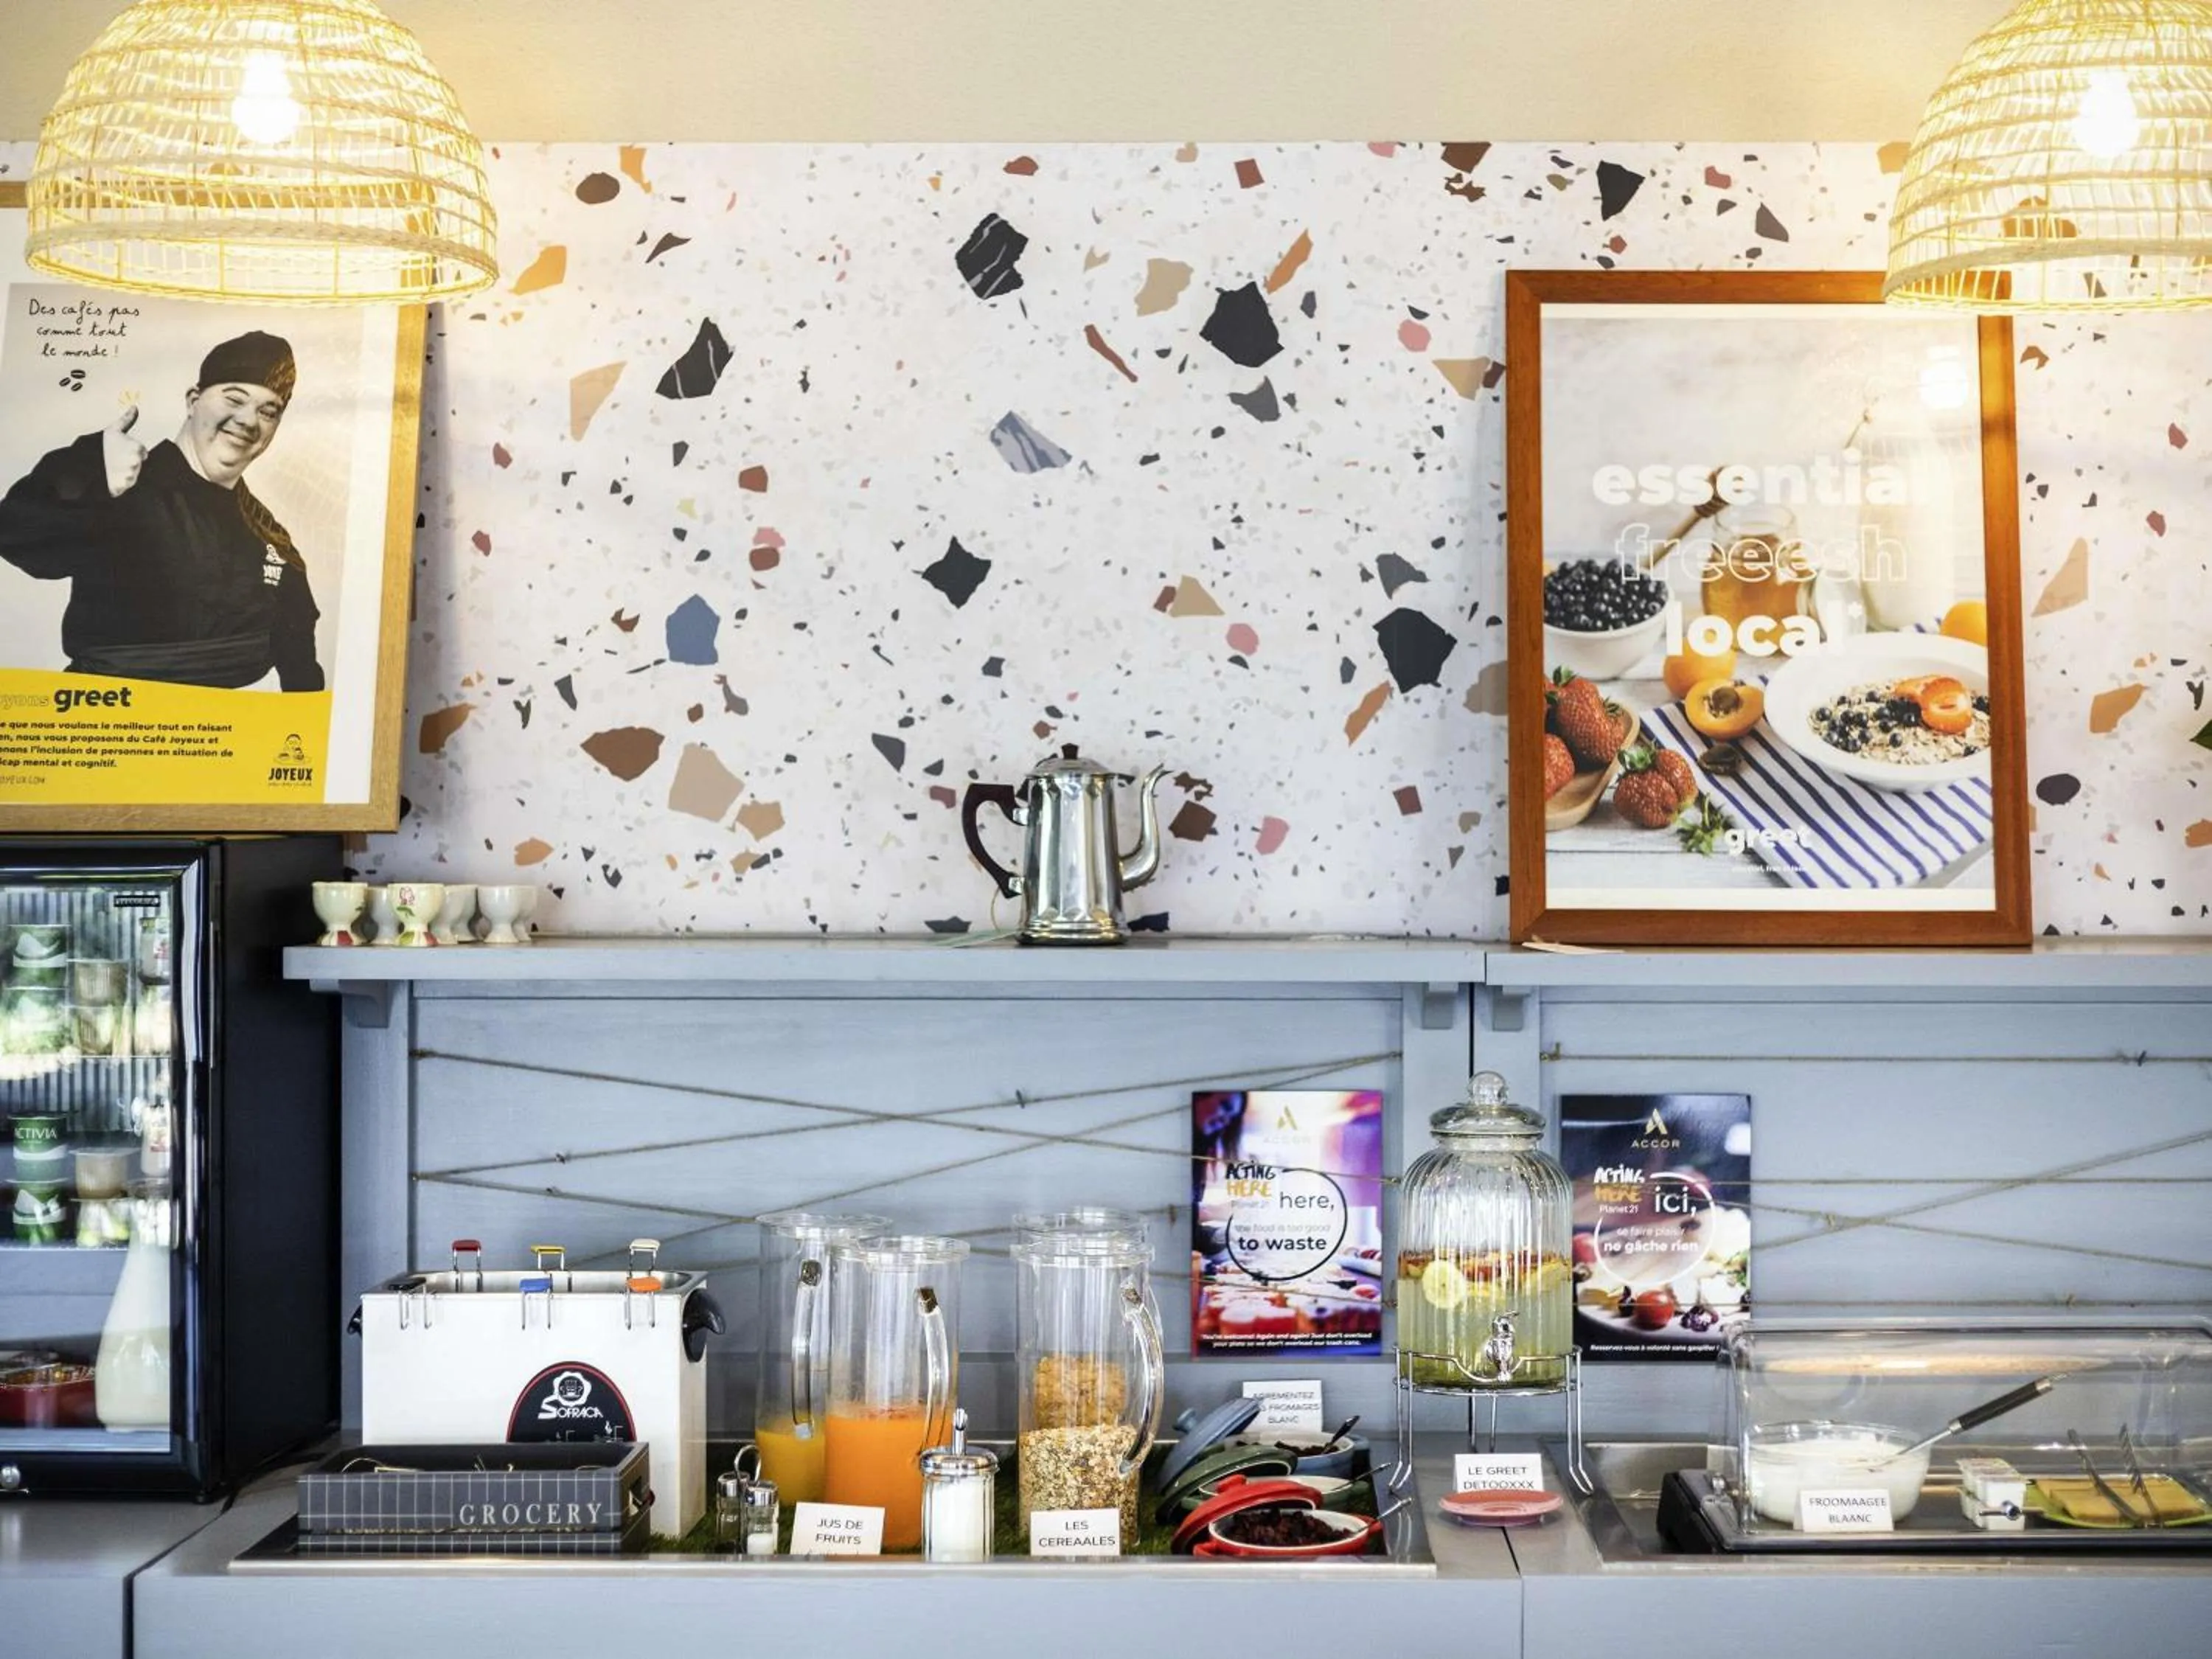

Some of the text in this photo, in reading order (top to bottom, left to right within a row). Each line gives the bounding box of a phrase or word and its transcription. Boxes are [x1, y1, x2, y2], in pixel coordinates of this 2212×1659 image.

[29, 299, 140, 324] Des cafés pas
[37, 321, 128, 337] comme tout
[41, 342, 57, 357] le
[63, 344, 108, 357] monde
[1592, 448, 1928, 507] essentia
[1614, 521, 1910, 582] freeesh
[54, 686, 132, 713] greet
[9, 722, 29, 730] que
[101, 722, 111, 730] le
[113, 723, 155, 731] meilleur
[198, 723, 232, 732] faisant
[70, 734, 124, 743] proposons
[127, 735, 139, 743] du
[142, 735, 166, 743] Café
[170, 737, 205, 745] Joyeux
[101, 748, 154, 757] personnes
[173, 748, 218, 757] situation
[220, 748, 233, 757] de
[23, 758, 60, 766] mental
[61, 759, 72, 767] et
[74, 758, 117, 769] cognitif.
[268, 768, 313, 780] JOYEUX
[1631, 1139, 1680, 1148] ACCOR
[1227, 1180, 1272, 1197] HERE
[1279, 1191, 1334, 1211] here,
[1655, 1186, 1697, 1217] ici,
[1599, 1204, 1628, 1214] Planet
[1239, 1237, 1326, 1251] to waste
[1604, 1242, 1621, 1252] ne
[1671, 1240, 1699, 1252] rien
[1268, 1415, 1299, 1424] BLANC
[1468, 1467, 1528, 1475] LE GREET
[1464, 1481, 1534, 1490] DETOOXXX
[1809, 1498, 1886, 1506] FROOMAAGEE
[459, 1503, 602, 1525] GROCERY
[1829, 1514, 1872, 1523] BLAANC
[817, 1518, 863, 1530] JUS DE
[1065, 1521, 1089, 1531] LES
[815, 1533, 861, 1545] FRUITS
[1039, 1536, 1116, 1548] CEREAALES
